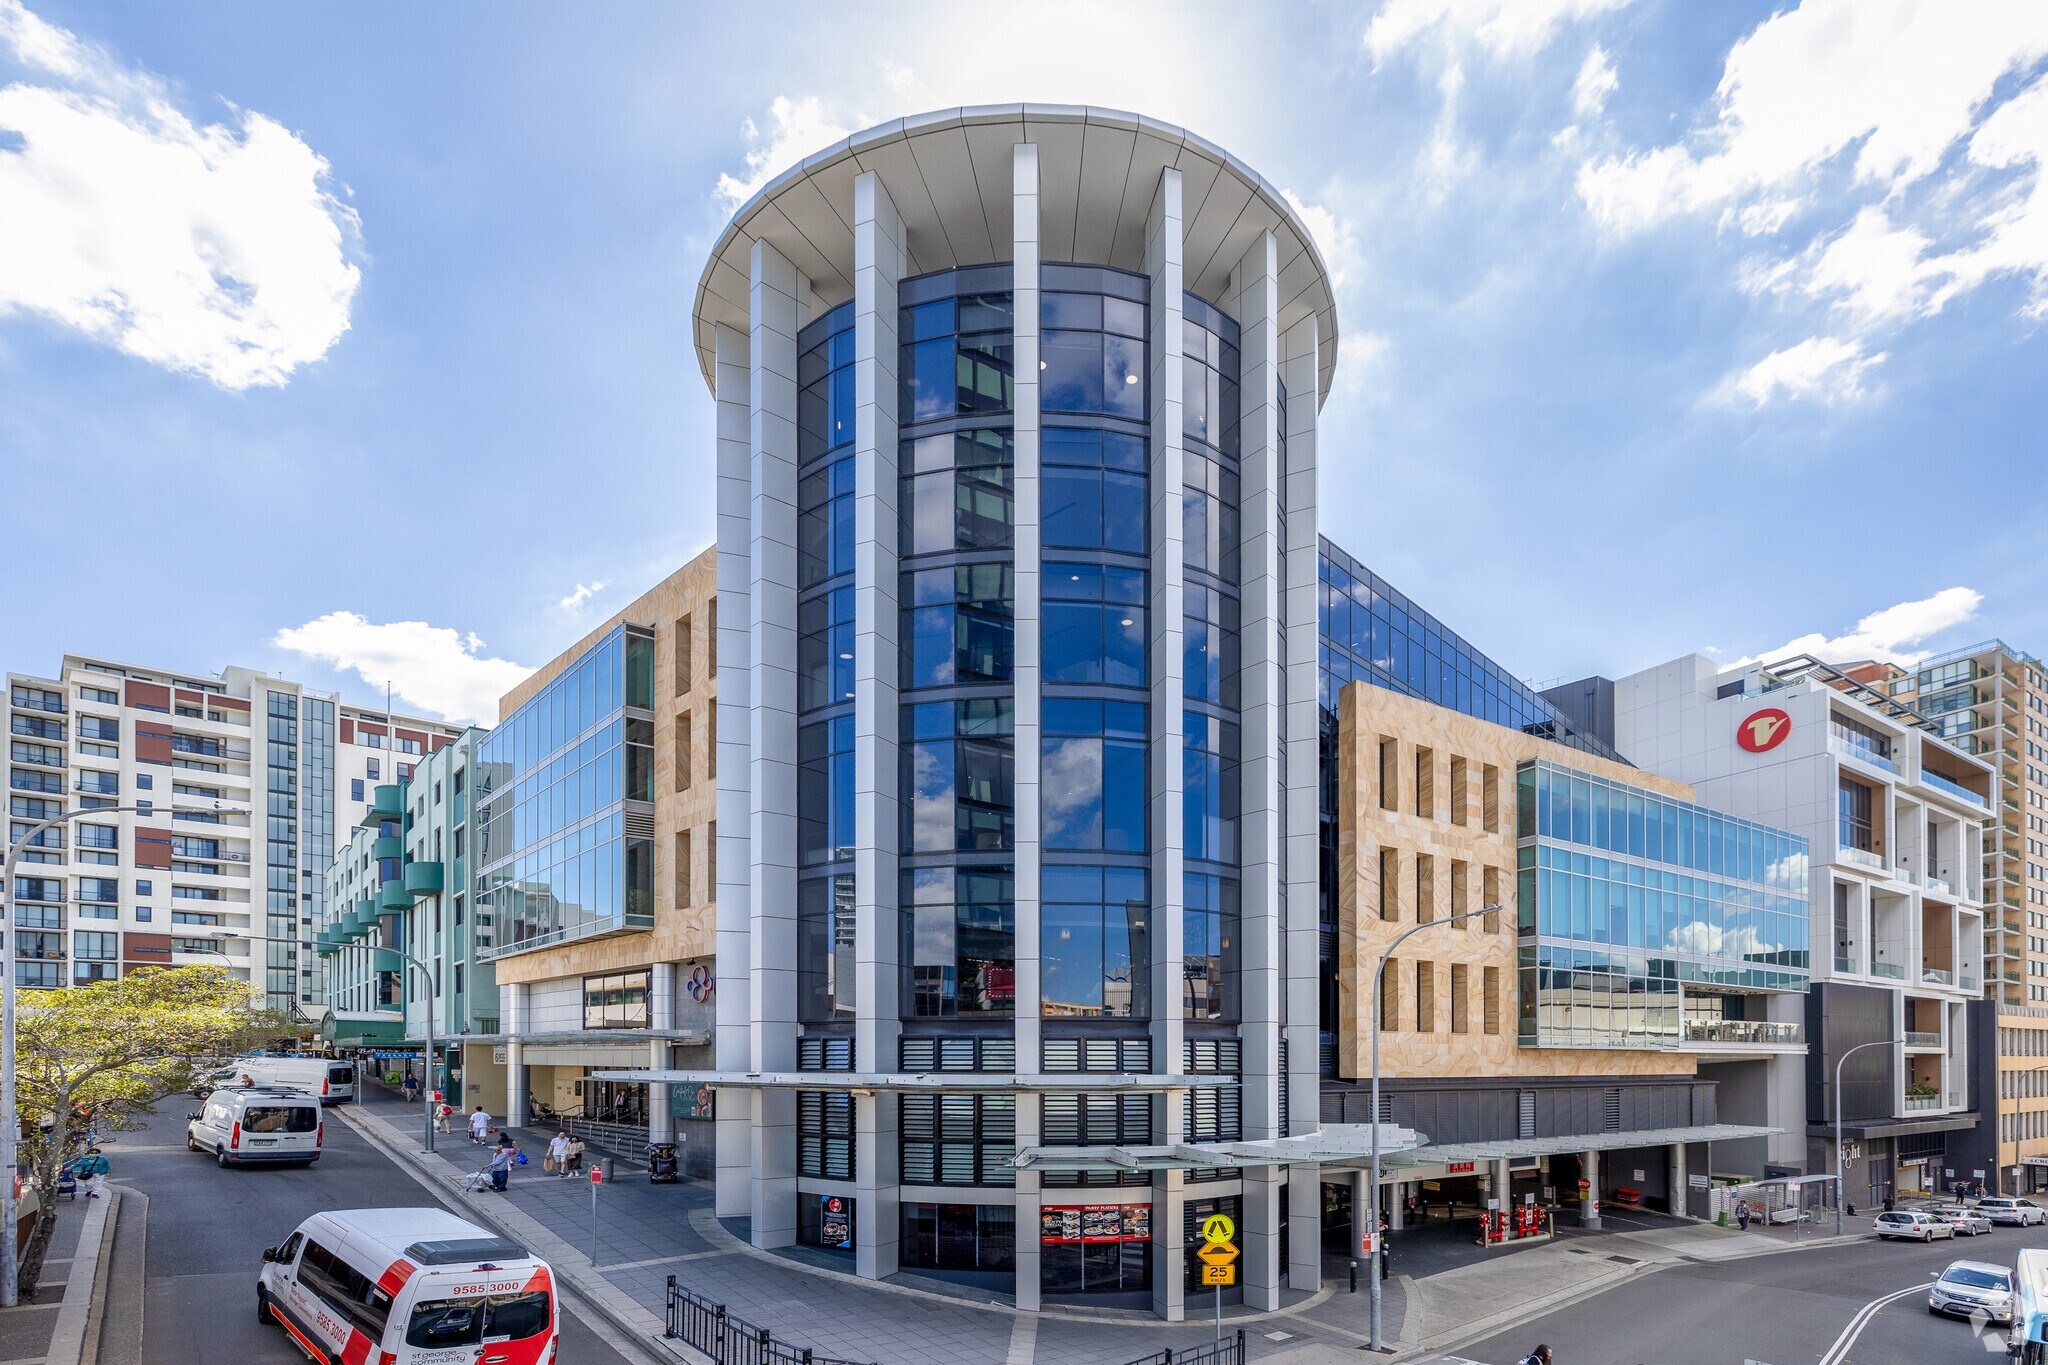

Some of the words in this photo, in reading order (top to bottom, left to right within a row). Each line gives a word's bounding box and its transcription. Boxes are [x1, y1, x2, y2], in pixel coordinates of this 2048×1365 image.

[1840, 1144, 1861, 1169] ight
[1209, 1267, 1228, 1278] 25
[453, 1286, 485, 1295] 9585
[489, 1282, 519, 1292] 3000
[316, 1310, 331, 1332] 9585
[330, 1322, 346, 1345] 3000
[410, 1355, 466, 1365] community
[421, 1350, 457, 1361] george
